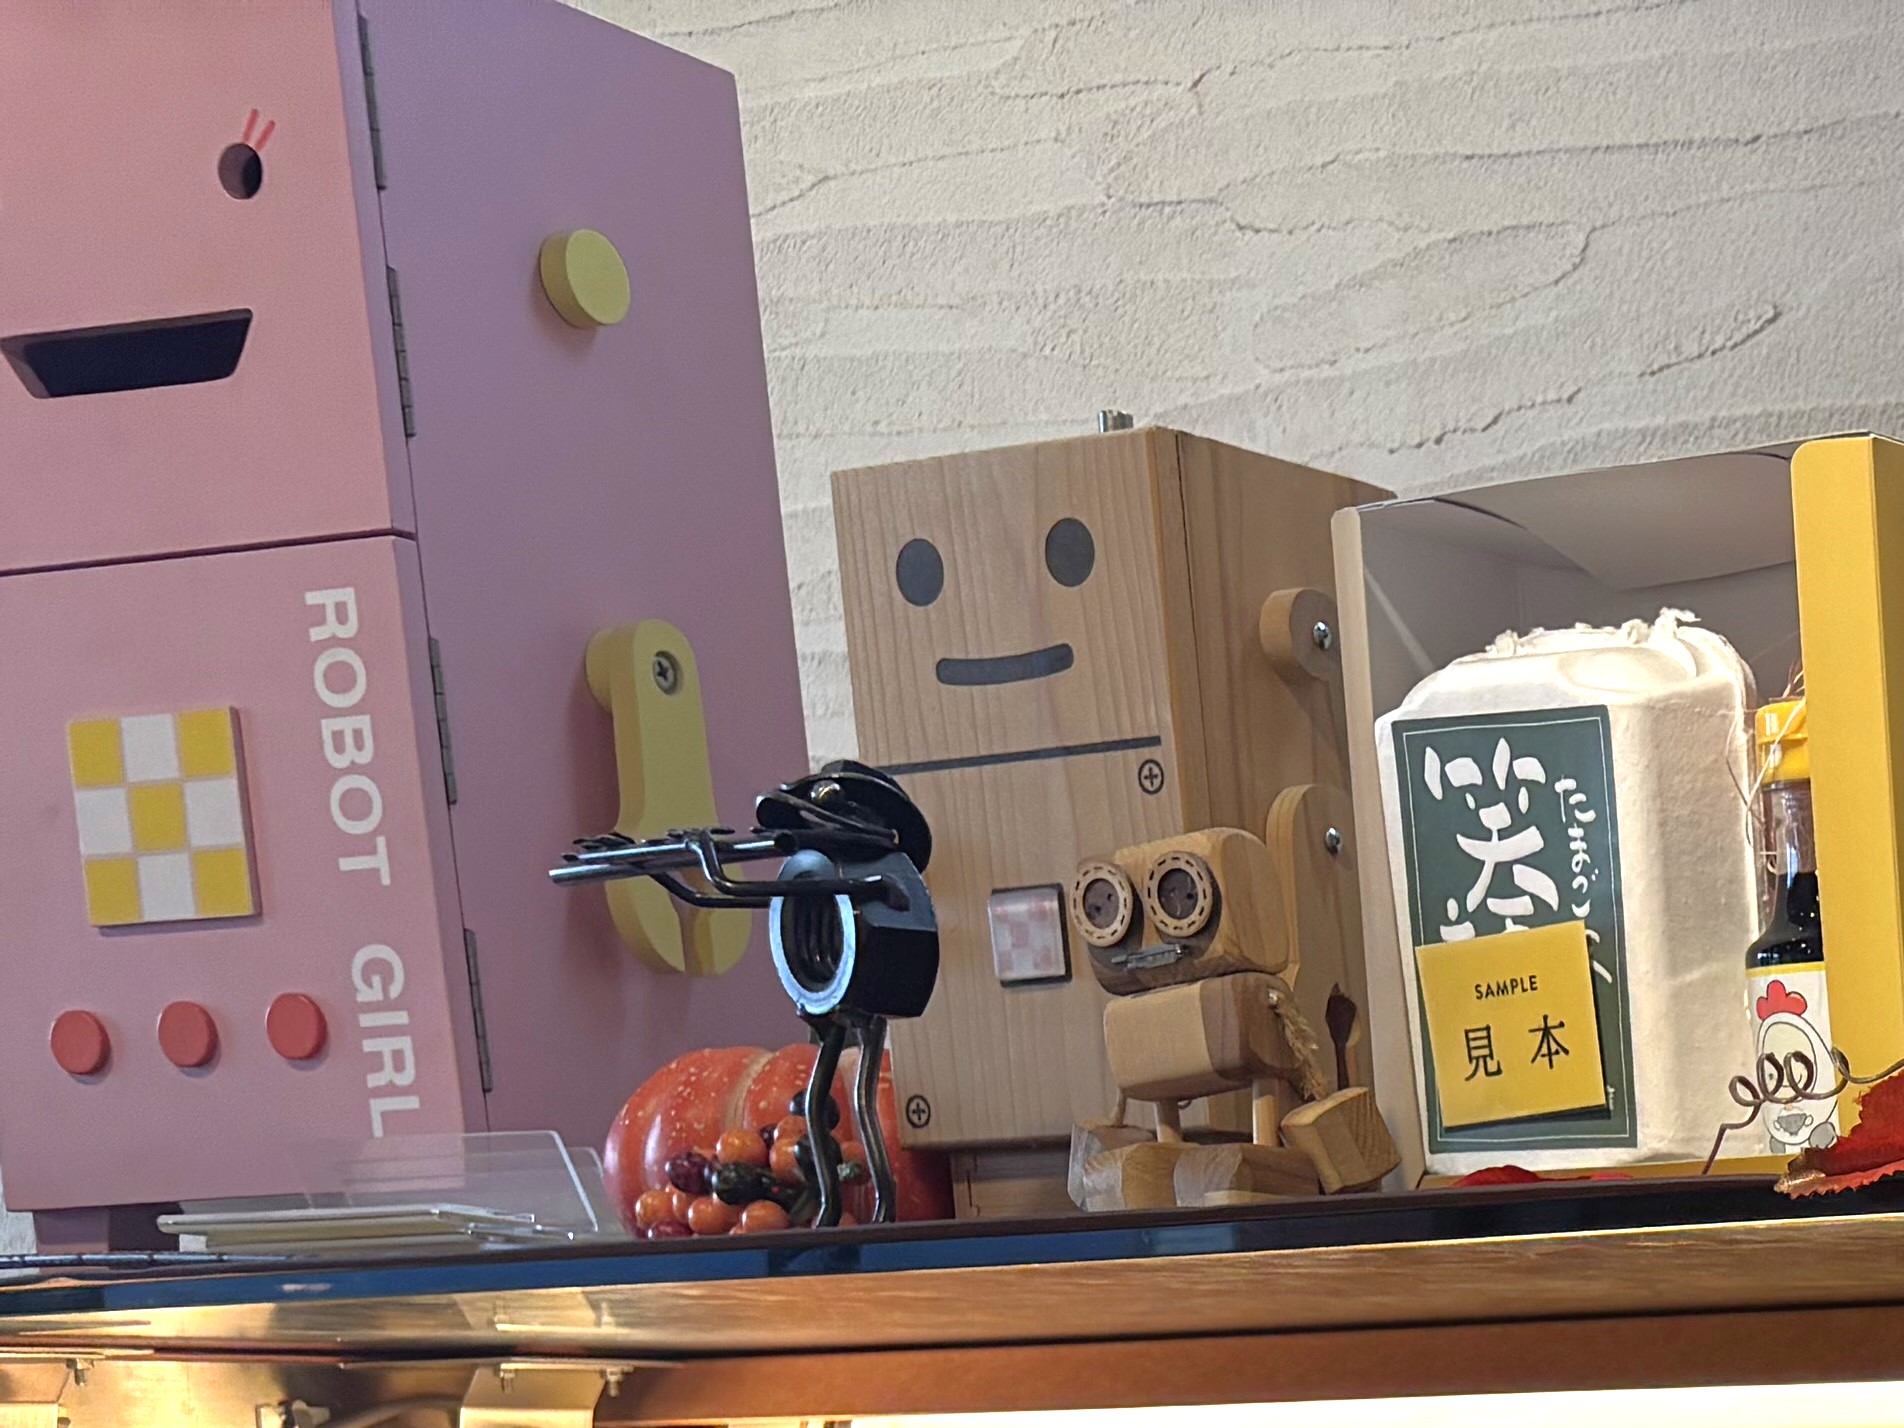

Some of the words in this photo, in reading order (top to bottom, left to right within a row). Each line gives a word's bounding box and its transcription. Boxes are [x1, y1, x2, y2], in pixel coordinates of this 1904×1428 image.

[305, 587, 391, 886] ROBOT
[351, 943, 421, 1138] GIRL
[1474, 975, 1539, 1000] SAMPLE
